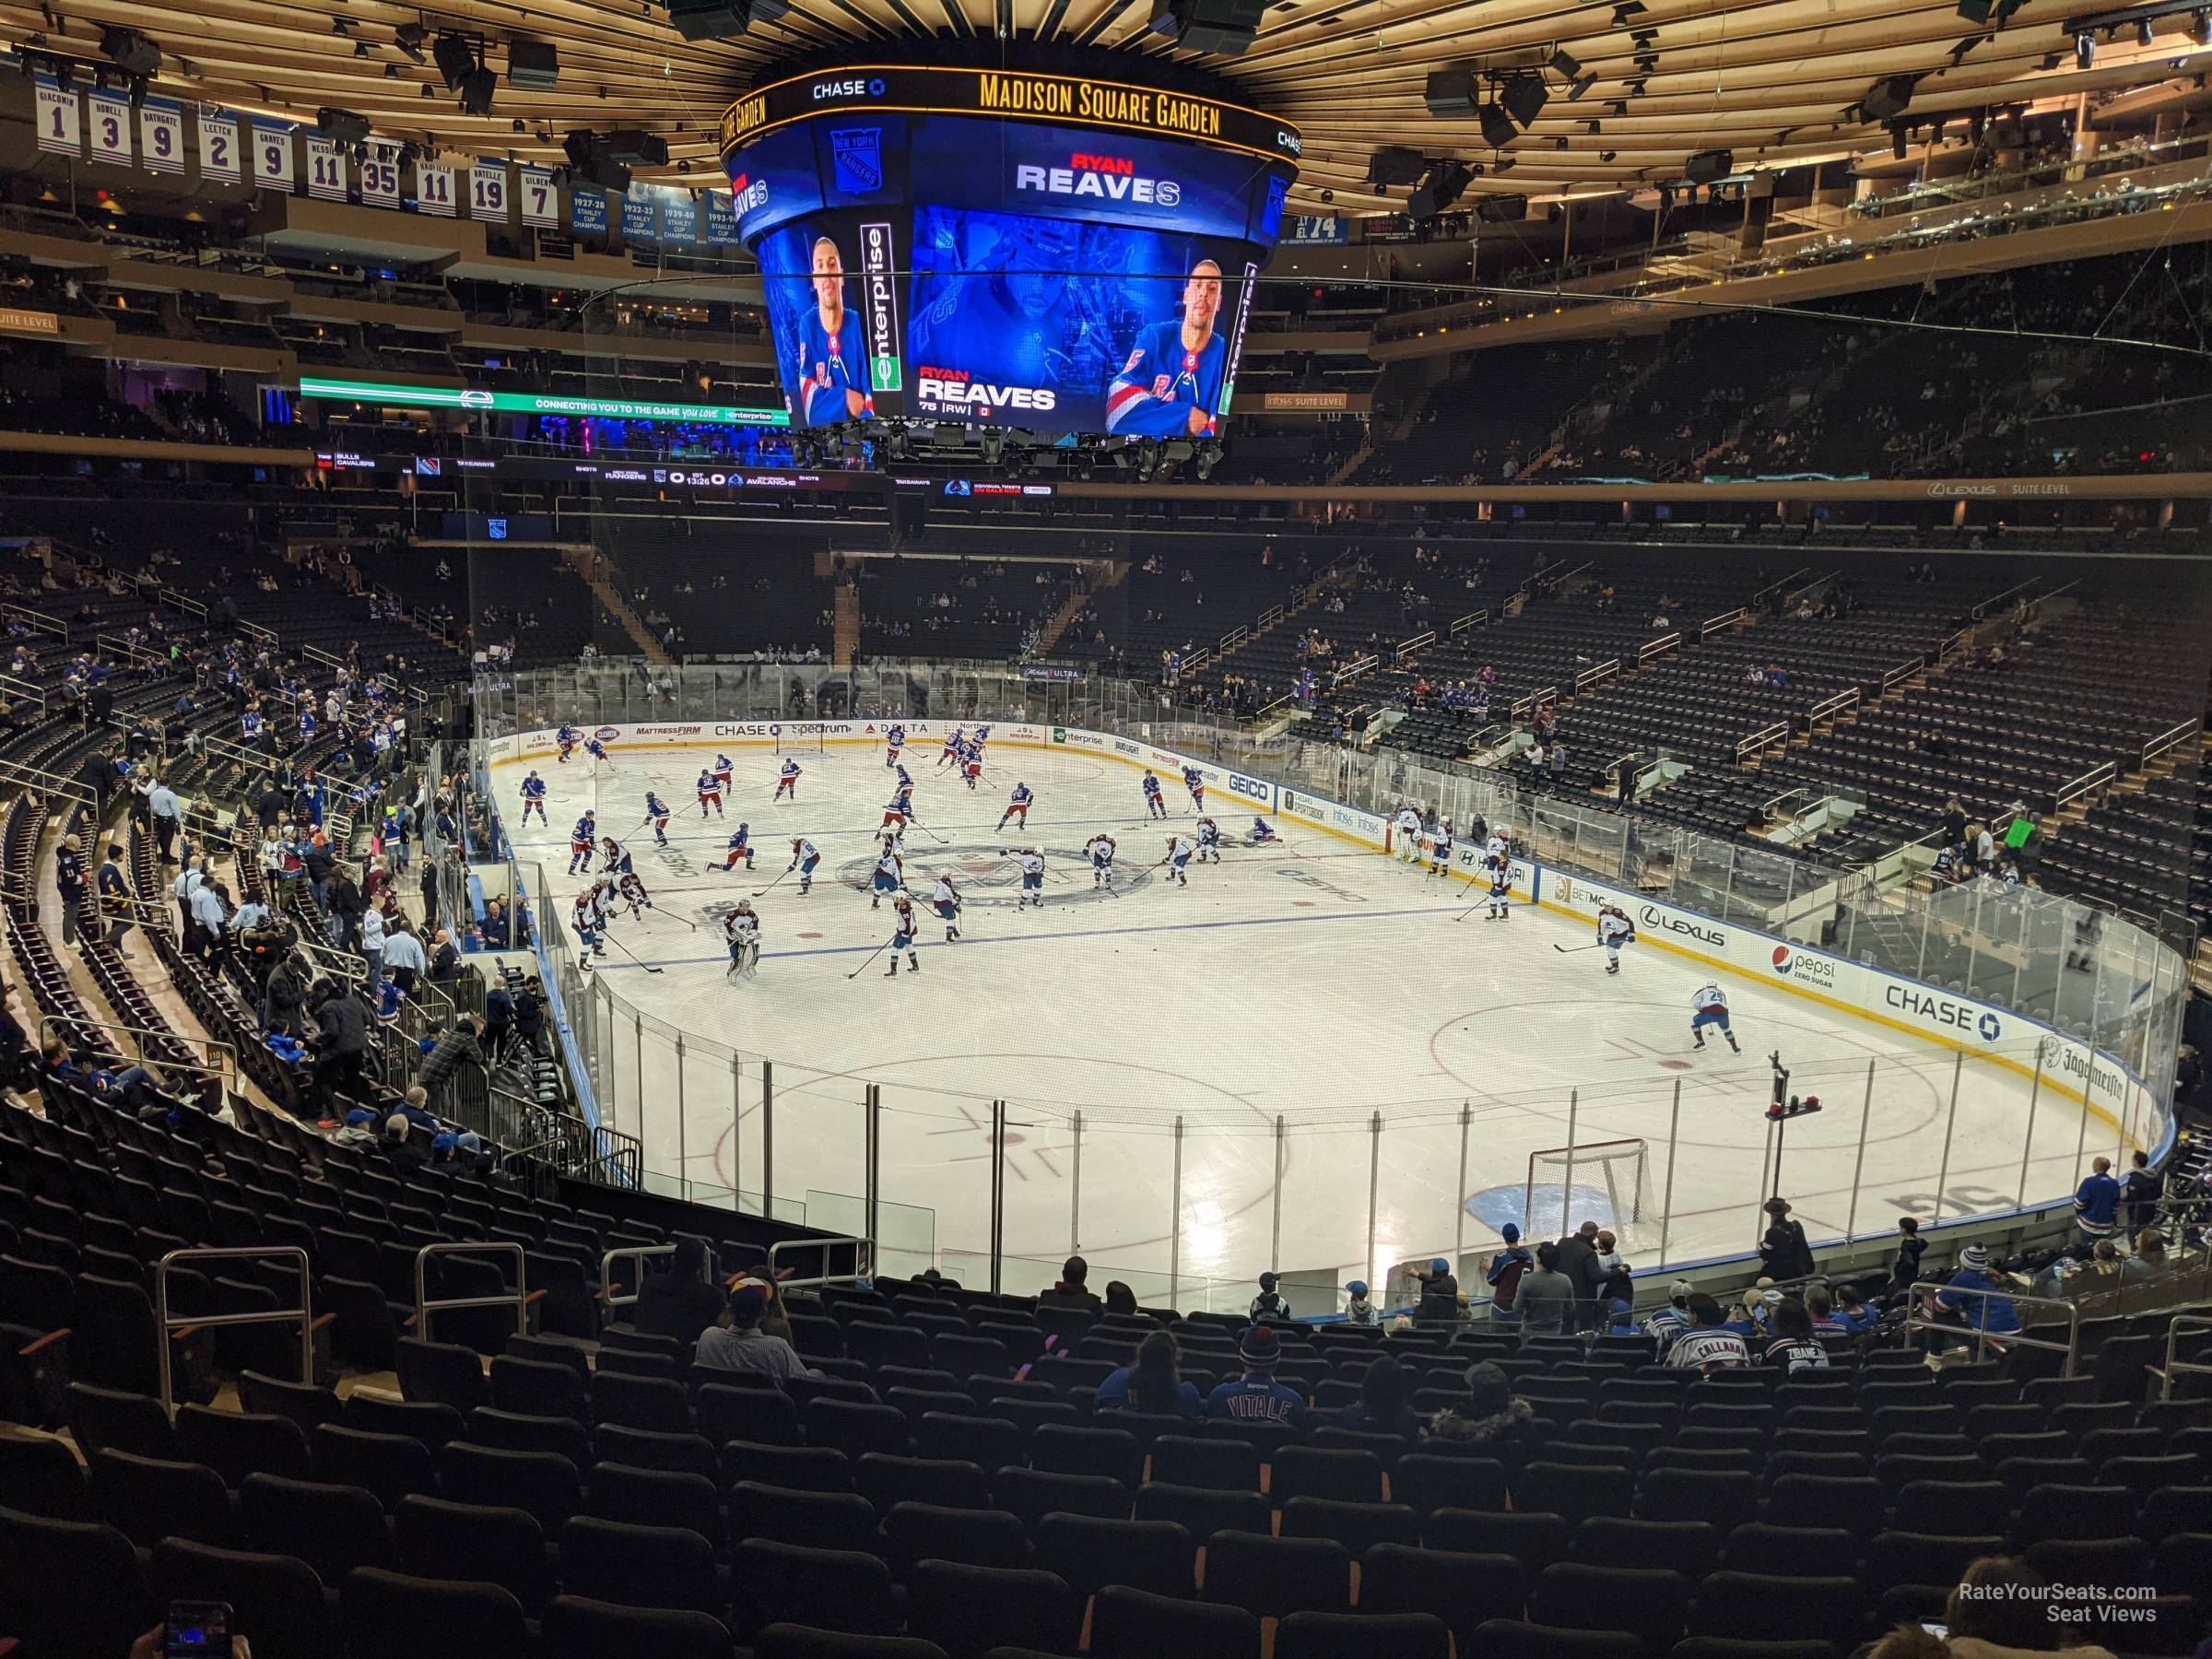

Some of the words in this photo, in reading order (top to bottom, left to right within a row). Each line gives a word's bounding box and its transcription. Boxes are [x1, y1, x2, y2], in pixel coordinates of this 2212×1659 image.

[814, 80, 865, 100] CHASE
[96, 103, 123, 117] HOWELL
[981, 75, 1072, 113] MADISON
[1079, 83, 1150, 124] SQUARE
[1158, 94, 1220, 135] GARDEN
[52, 107, 65, 138] 1
[144, 113, 178, 127] BATHGATE
[736, 96, 766, 135] GARDEN
[102, 117, 119, 148] 3
[204, 124, 231, 136] LEETCH
[154, 126, 171, 157] 9
[259, 134, 285, 146] GRAVES
[211, 136, 228, 167] 2
[312, 145, 337, 156] MESSIE
[265, 147, 281, 175] 9
[841, 152, 877, 184] RANGERS
[1071, 153, 1134, 175] RYAN
[314, 156, 339, 187] 11
[364, 163, 395, 194] 35
[474, 170, 502, 182] RATELLE
[425, 173, 449, 202] 11
[1017, 164, 1180, 206] REAVES
[475, 180, 502, 208] 19
[532, 187, 547, 214] 7
[574, 197, 606, 209] 1927-28
[624, 204, 653, 216] 1932-33
[577, 208, 602, 217] STANLEY
[627, 214, 651, 223] STANLEY
[665, 209, 695, 219] 1939-40
[573, 221, 606, 231] CHAMPIONS
[667, 218, 691, 228] STANLEY
[622, 227, 654, 237] CHAMPIONS
[664, 231, 695, 241] CHAMPIONS
[708, 235, 738, 244] CHAMPIONS
[868, 228, 892, 386] enterprise
[24, 316, 54, 328] LEVEL
[920, 366, 970, 382] RYAN
[919, 379, 1055, 411] REAVES
[1295, 397, 1318, 406] SUITE
[1320, 397, 1343, 406] LEVEL
[535, 399, 597, 411] CONNECTING
[599, 403, 618, 413] YOU
[620, 405, 632, 414] TO
[634, 406, 652, 415] THE
[653, 406, 680, 417] GAME
[727, 411, 772, 421] enterprise
[606, 472, 646, 480] RANGERS
[670, 472, 685, 484] 0
[687, 477, 710, 486] 13:26
[711, 474, 725, 485] 0
[747, 478, 796, 487] AVALANCHE
[1947, 486, 1996, 495] LEXUS
[2013, 484, 2040, 495] SUITE
[2041, 484, 2070, 495] LEVEL
[1053, 669, 1078, 678] ULTRA
[715, 724, 765, 735] CHASE
[1057, 731, 1103, 747] enterprise
[1115, 741, 1125, 750] BUD
[1125, 743, 1139, 756] LIGHT
[1230, 774, 1267, 800] GEICO
[1294, 802, 1324, 821] SPORTSBOOK
[1663, 915, 1724, 947] LEXUS
[1794, 955, 1836, 978] pepsi
[1794, 971, 1810, 982] ZERO
[1811, 975, 1833, 989] SUGAR
[1710, 991, 1724, 1002] 25
[1886, 984, 1974, 1031] CHASE
[1227, 1394, 1292, 1423] VITALE
